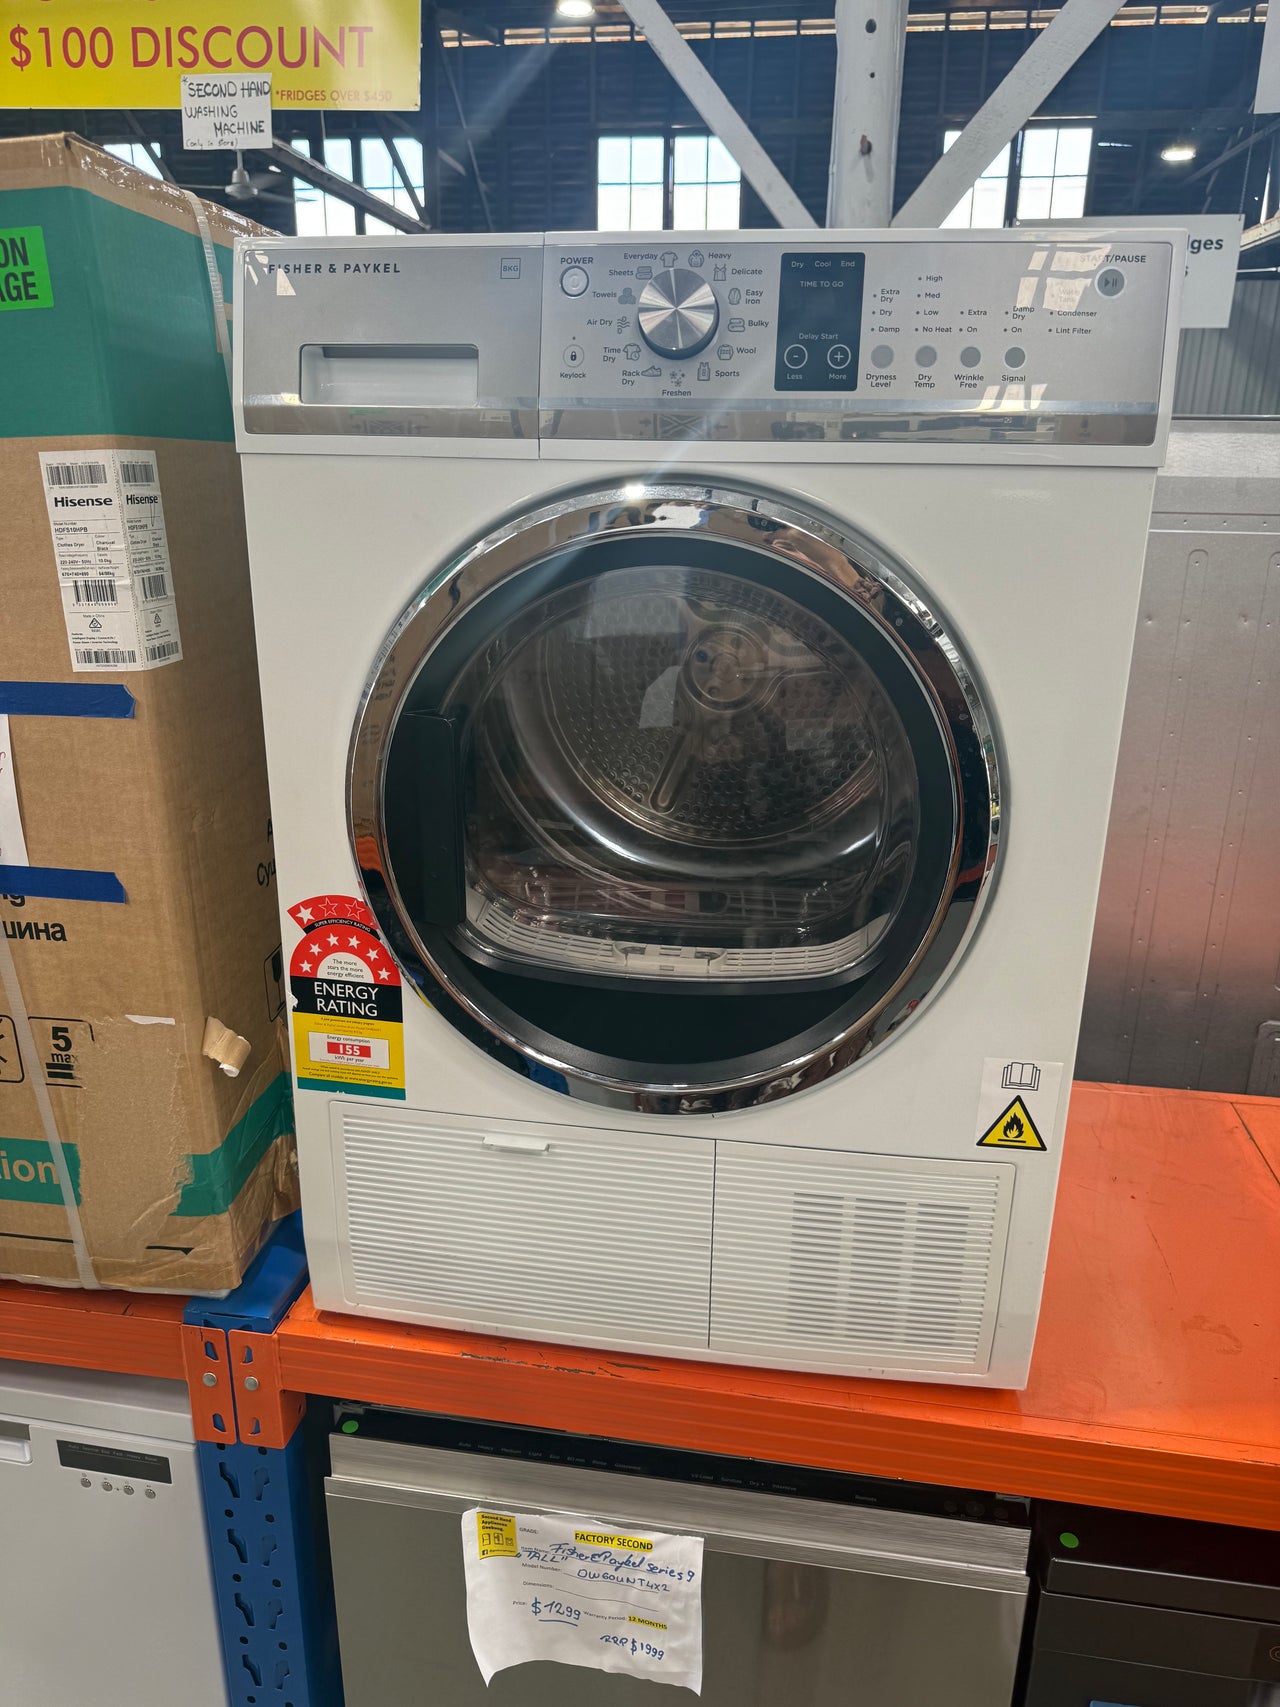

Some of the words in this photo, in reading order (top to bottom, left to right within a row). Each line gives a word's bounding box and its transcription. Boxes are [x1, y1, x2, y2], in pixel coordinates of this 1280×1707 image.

[10, 24, 114, 72] $100
[131, 25, 374, 69] DISCOUNT
[188, 81, 237, 98] SECOND
[240, 81, 271, 98] HAND
[330, 90, 360, 101] OVER
[184, 104, 238, 119] WASHING
[214, 120, 265, 138] MACHINE
[560, 257, 594, 265] POWER
[623, 252, 658, 261] Everyday
[708, 252, 732, 260] Heavy
[329, 263, 337, 274] &
[344, 262, 401, 274] PAYKEL
[502, 265, 519, 273] 8KG
[791, 261, 804, 269] Dry
[745, 289, 764, 297] Easy
[599, 319, 613, 327] Dry
[748, 320, 769, 328] Bulky
[602, 355, 616, 363] Dry
[715, 370, 740, 378] Sports
[621, 378, 635, 386] Dry
[54, 497, 113, 507] Hisense
[126, 494, 158, 507] Hisense
[314, 981, 379, 1000] ENERGY
[316, 1000, 378, 1017] RATING
[52, 1027, 72, 1051] 5
[342, 1036, 370, 1044] consumption
[339, 1044, 360, 1055] 155
[0, 1151, 60, 1184] ion
[575, 1533, 615, 1544] FACTORY
[617, 1537, 653, 1551] SECOND
[531, 1597, 581, 1620] $1299
[638, 1618, 667, 1630] MONTHS
[631, 1638, 664, 1660] $1999
